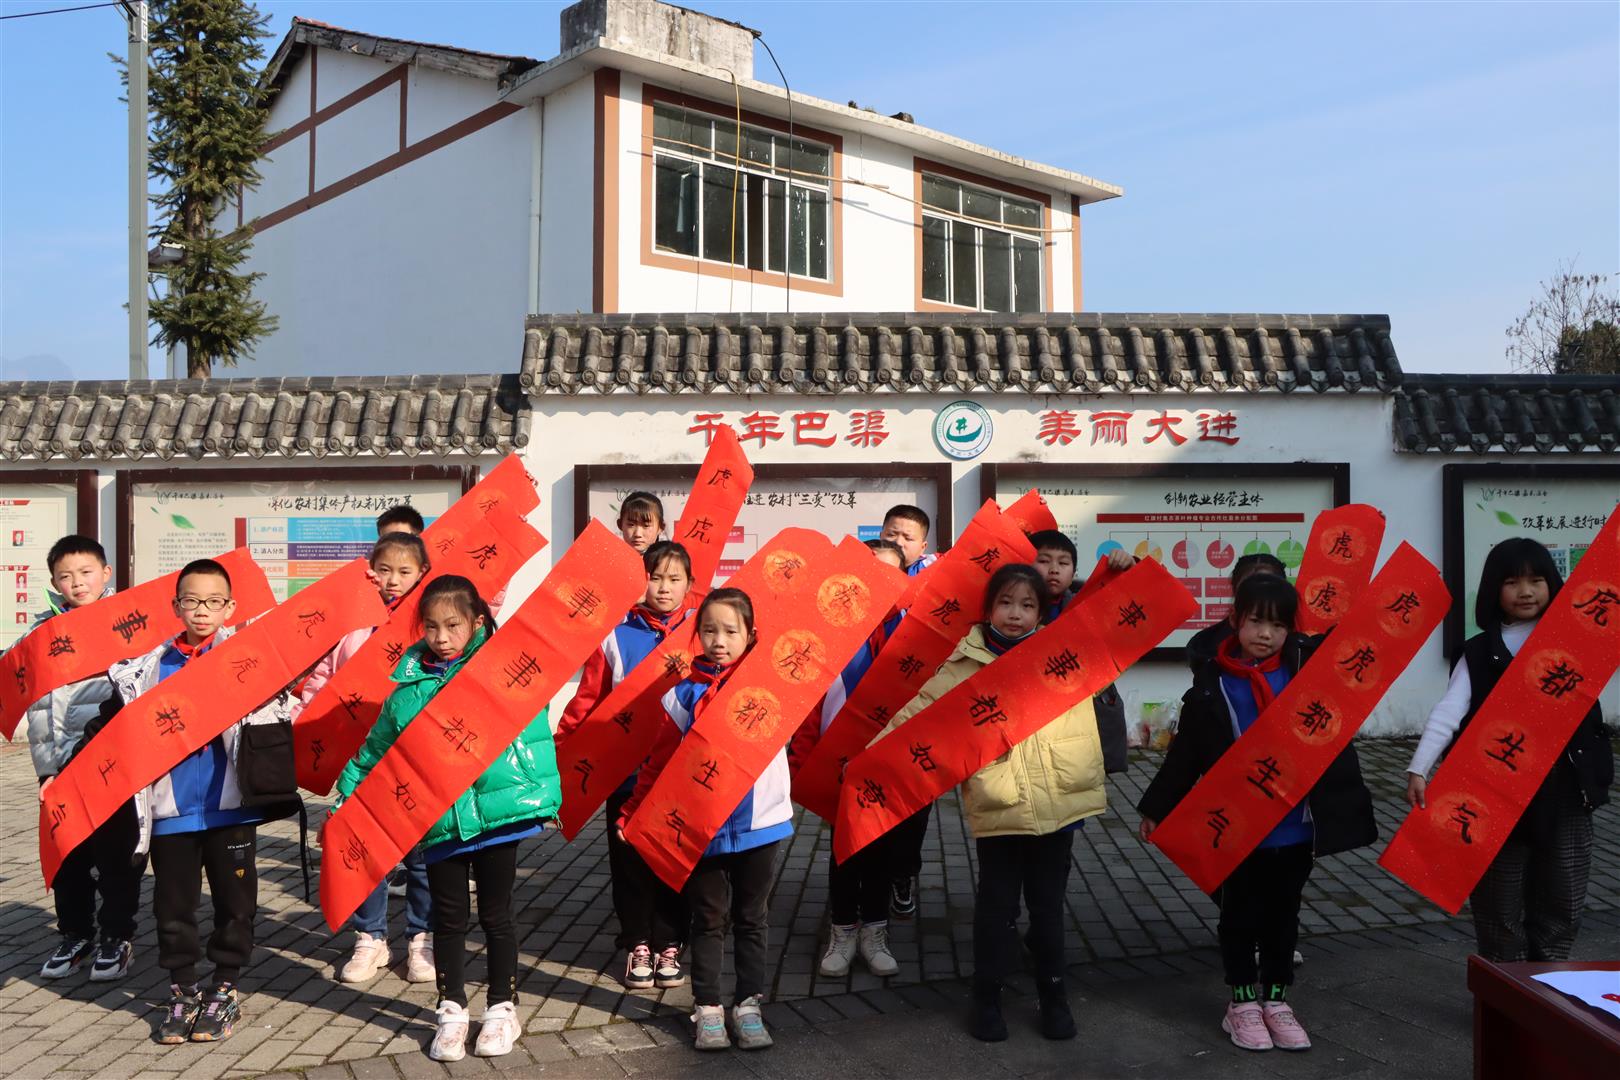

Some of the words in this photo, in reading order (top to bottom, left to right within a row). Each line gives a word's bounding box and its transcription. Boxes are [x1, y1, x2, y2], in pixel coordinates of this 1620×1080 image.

[688, 410, 890, 448] 千年巴渠
[1036, 410, 1241, 446] 美丽大进
[1164, 491, 1264, 508] 创新农业经营主体
[1522, 514, 1607, 532] 改革发展进行时
